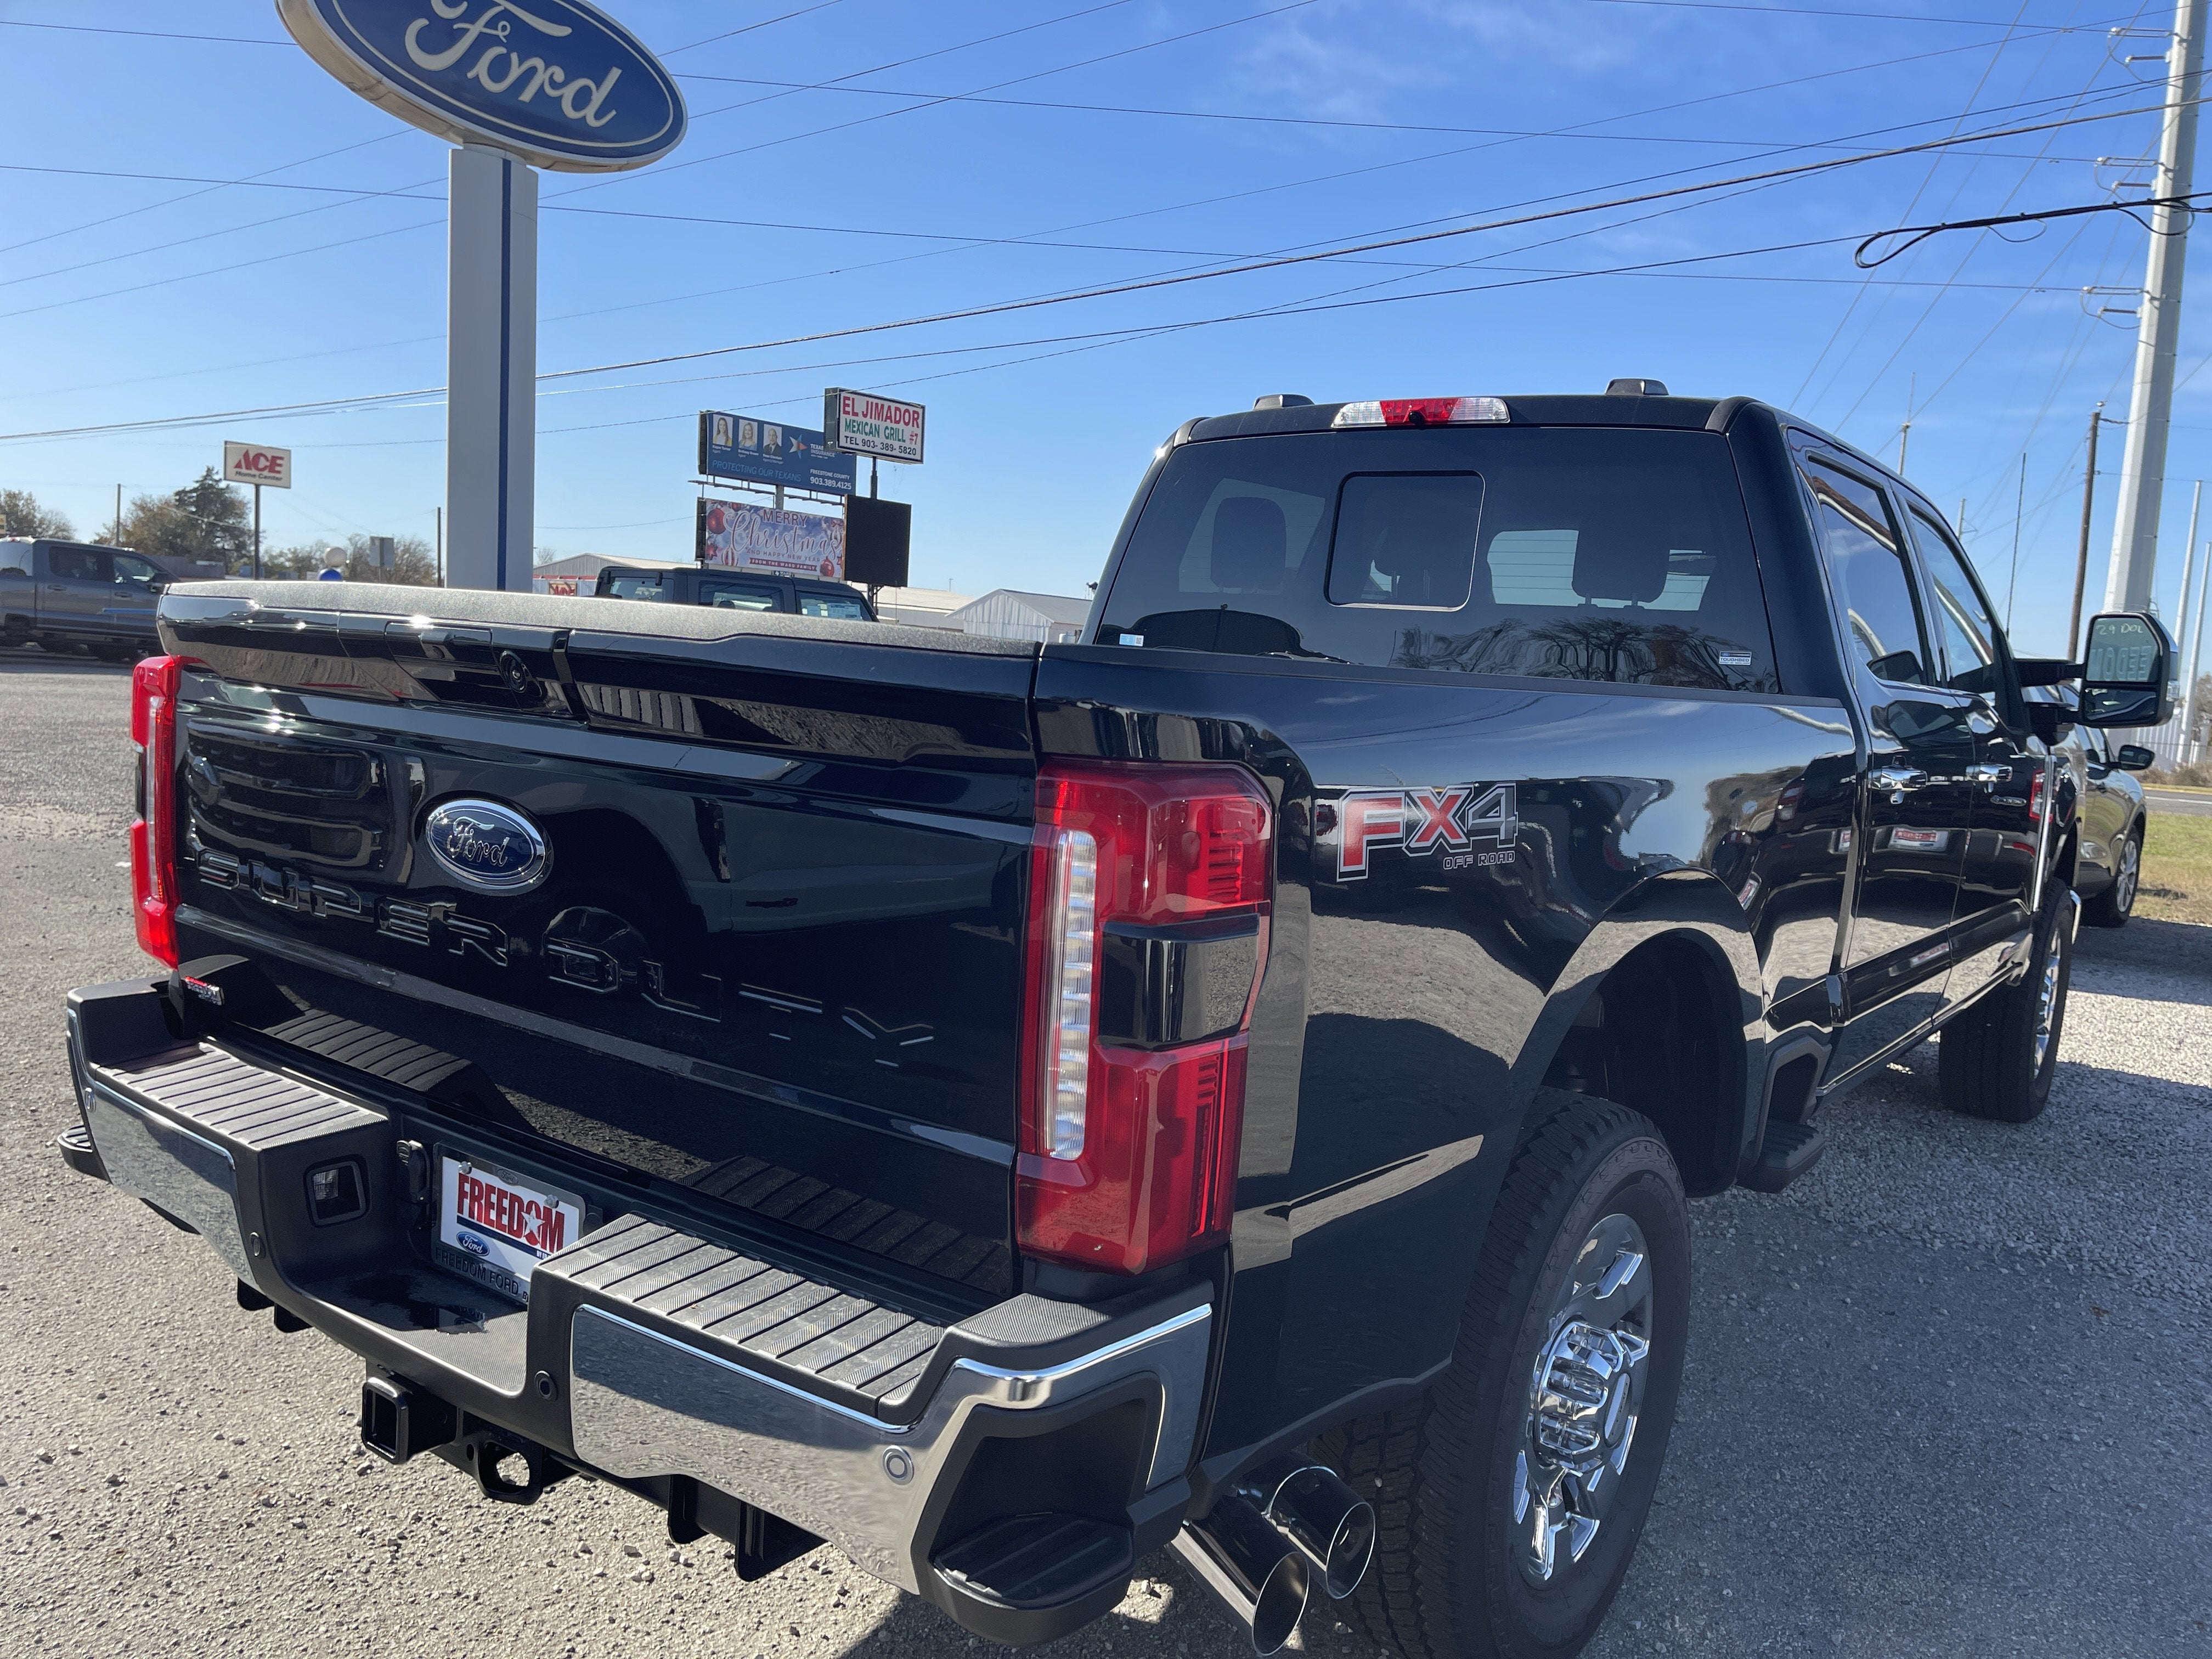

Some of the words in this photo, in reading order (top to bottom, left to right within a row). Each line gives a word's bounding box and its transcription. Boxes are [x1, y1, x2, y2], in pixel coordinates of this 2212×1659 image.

[404, 0, 622, 128] Ford
[843, 396, 859, 417] EL
[862, 400, 920, 428] JIMADOR
[845, 418, 880, 438] MEXICAN
[884, 426, 906, 443] GRILL
[909, 431, 918, 445] #7
[810, 449, 836, 458] INSURANCE
[844, 436, 859, 445] TEL
[899, 446, 916, 456] 5820
[233, 449, 284, 474] ACE
[712, 460, 757, 475] PROTECTING
[758, 468, 774, 477] OUR
[775, 470, 802, 482] TEXANS
[810, 469, 833, 477] FREESTONE
[235, 471, 256, 479] Home
[810, 477, 852, 490] 903.389.4125
[763, 509, 808, 528] MERRY
[723, 510, 844, 561] Christmas
[447, 816, 511, 868] Ford
[1336, 782, 1519, 882] FX4
[1443, 855, 1474, 870] OFF
[1477, 850, 1516, 866] ROAD
[196, 850, 509, 967] SUPER
[457, 1172, 565, 1254] FREEDOM
[462, 1234, 483, 1255] Ford
[435, 1249, 486, 1281] FREEDOM
[489, 1272, 519, 1295] FORD
